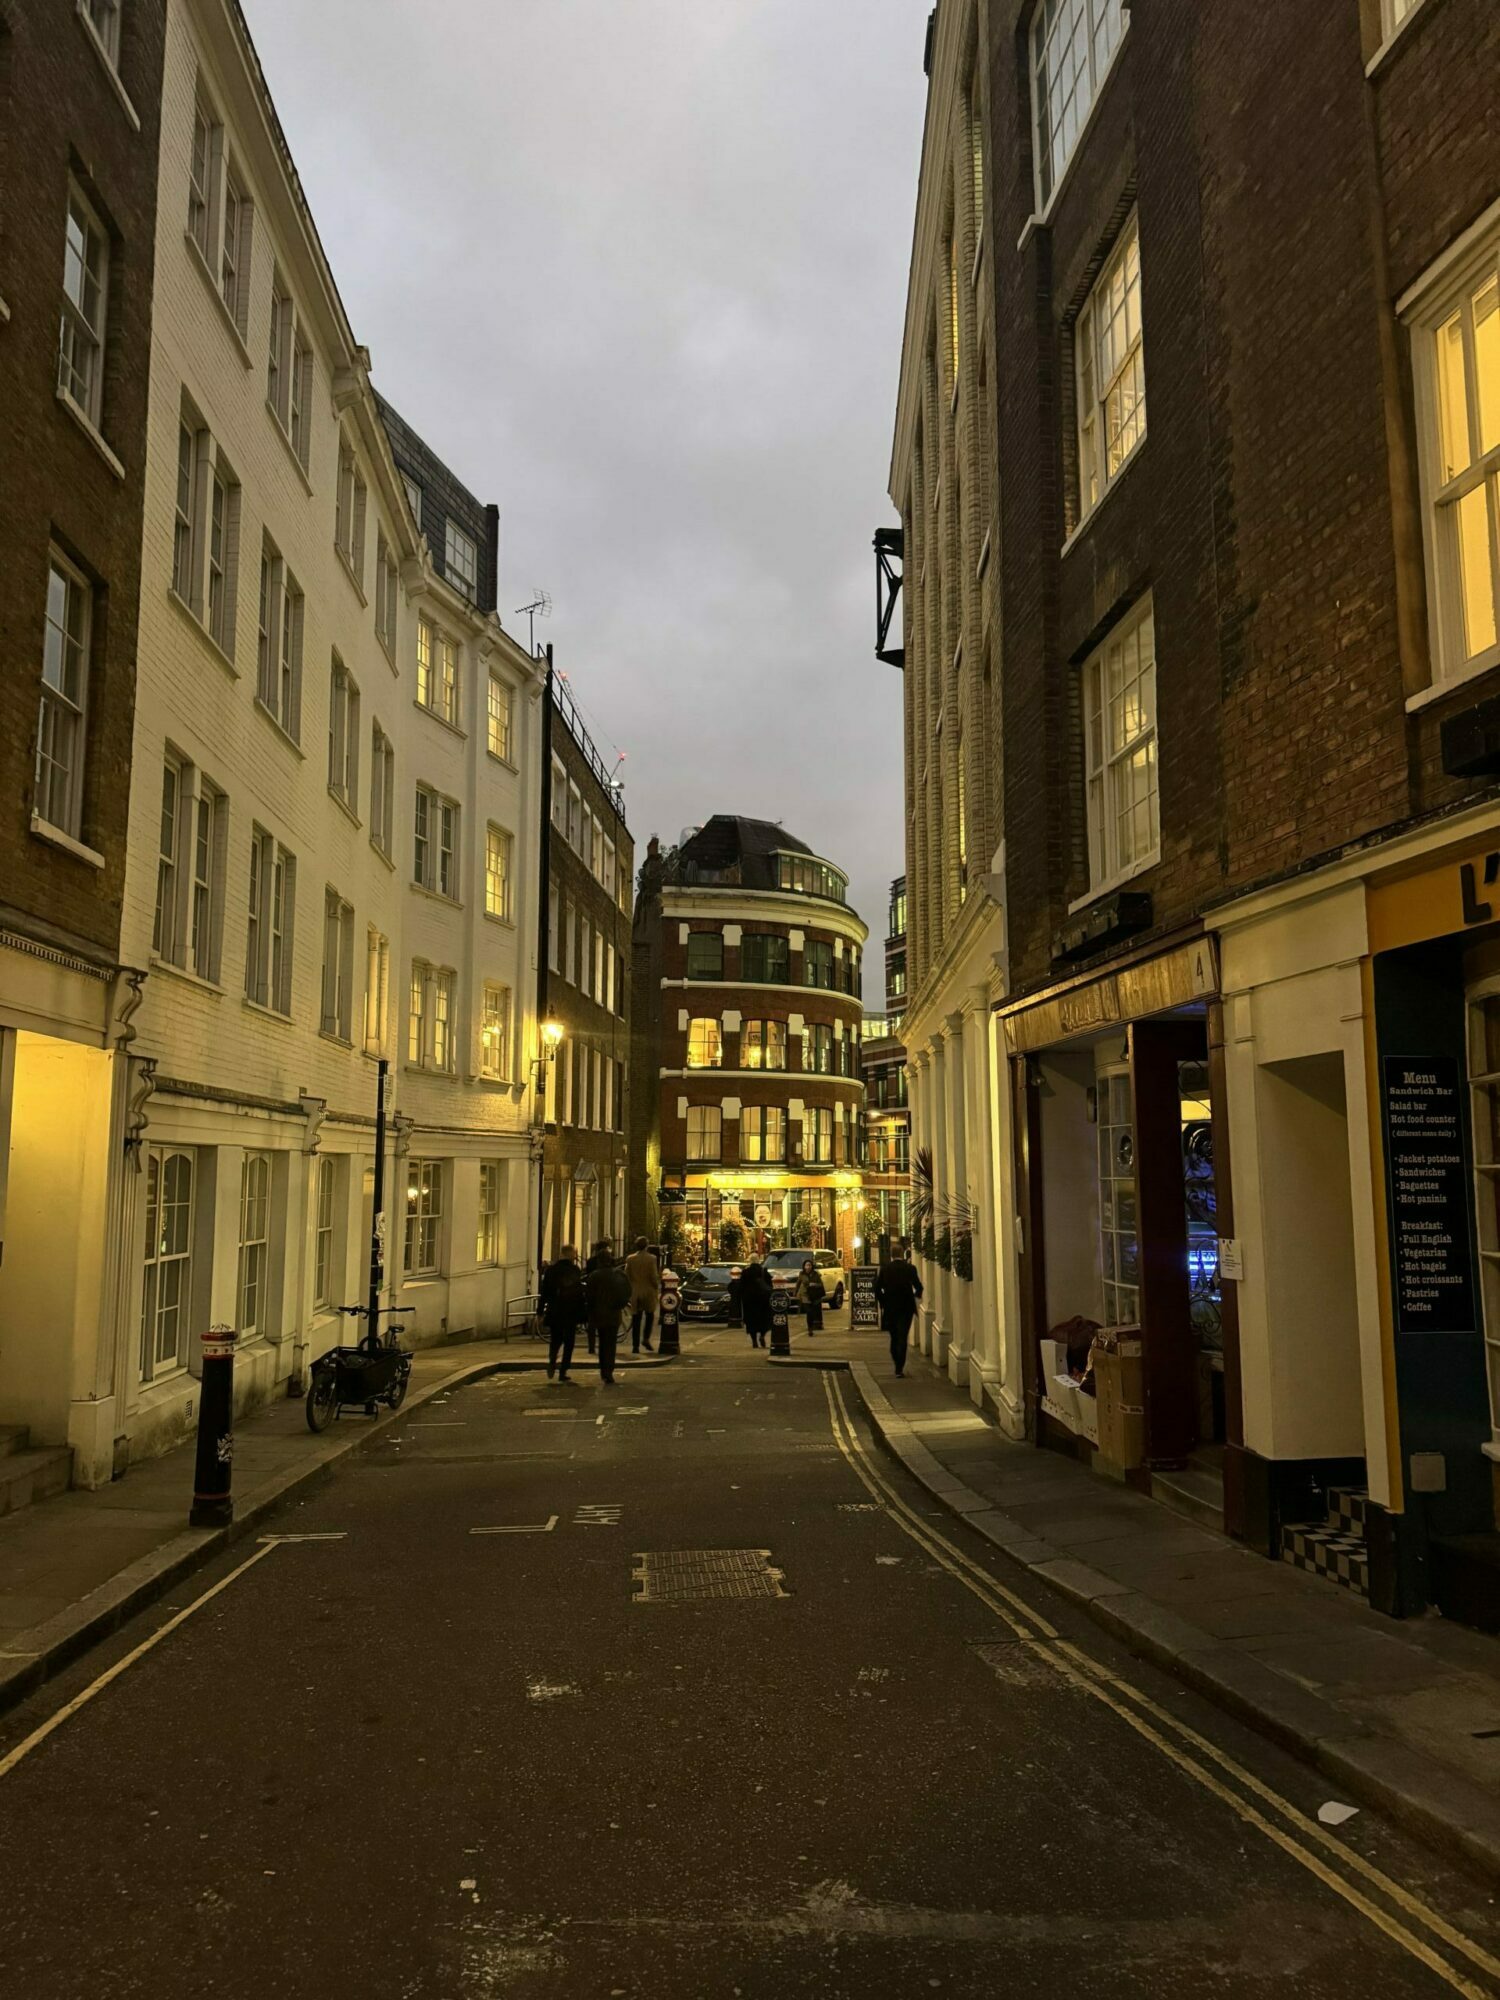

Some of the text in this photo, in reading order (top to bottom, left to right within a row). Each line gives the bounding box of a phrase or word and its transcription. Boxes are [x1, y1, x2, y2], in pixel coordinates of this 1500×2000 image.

[1403, 1071, 1437, 1084] Menu
[1389, 1087, 1453, 1095] Sandwich Bar
[1390, 1101, 1428, 1110] Salad bar
[1390, 1114, 1456, 1123] Hot food counter
[1398, 1154, 1460, 1165] Jacket potatoes
[1399, 1168, 1446, 1177] Sandwiches
[1399, 1181, 1440, 1192] Baguettes
[1400, 1194, 1447, 1205] Hot paninis
[1401, 1221, 1443, 1230] Breakfast:
[1402, 1234, 1452, 1245] Full English
[1403, 1248, 1447, 1259] Vegetarian
[1404, 1261, 1447, 1272] Hot bagels
[1405, 1274, 1463, 1284] Hot croissants
[1406, 1288, 1440, 1297] Pastries
[1407, 1302, 1432, 1311] Coffee
